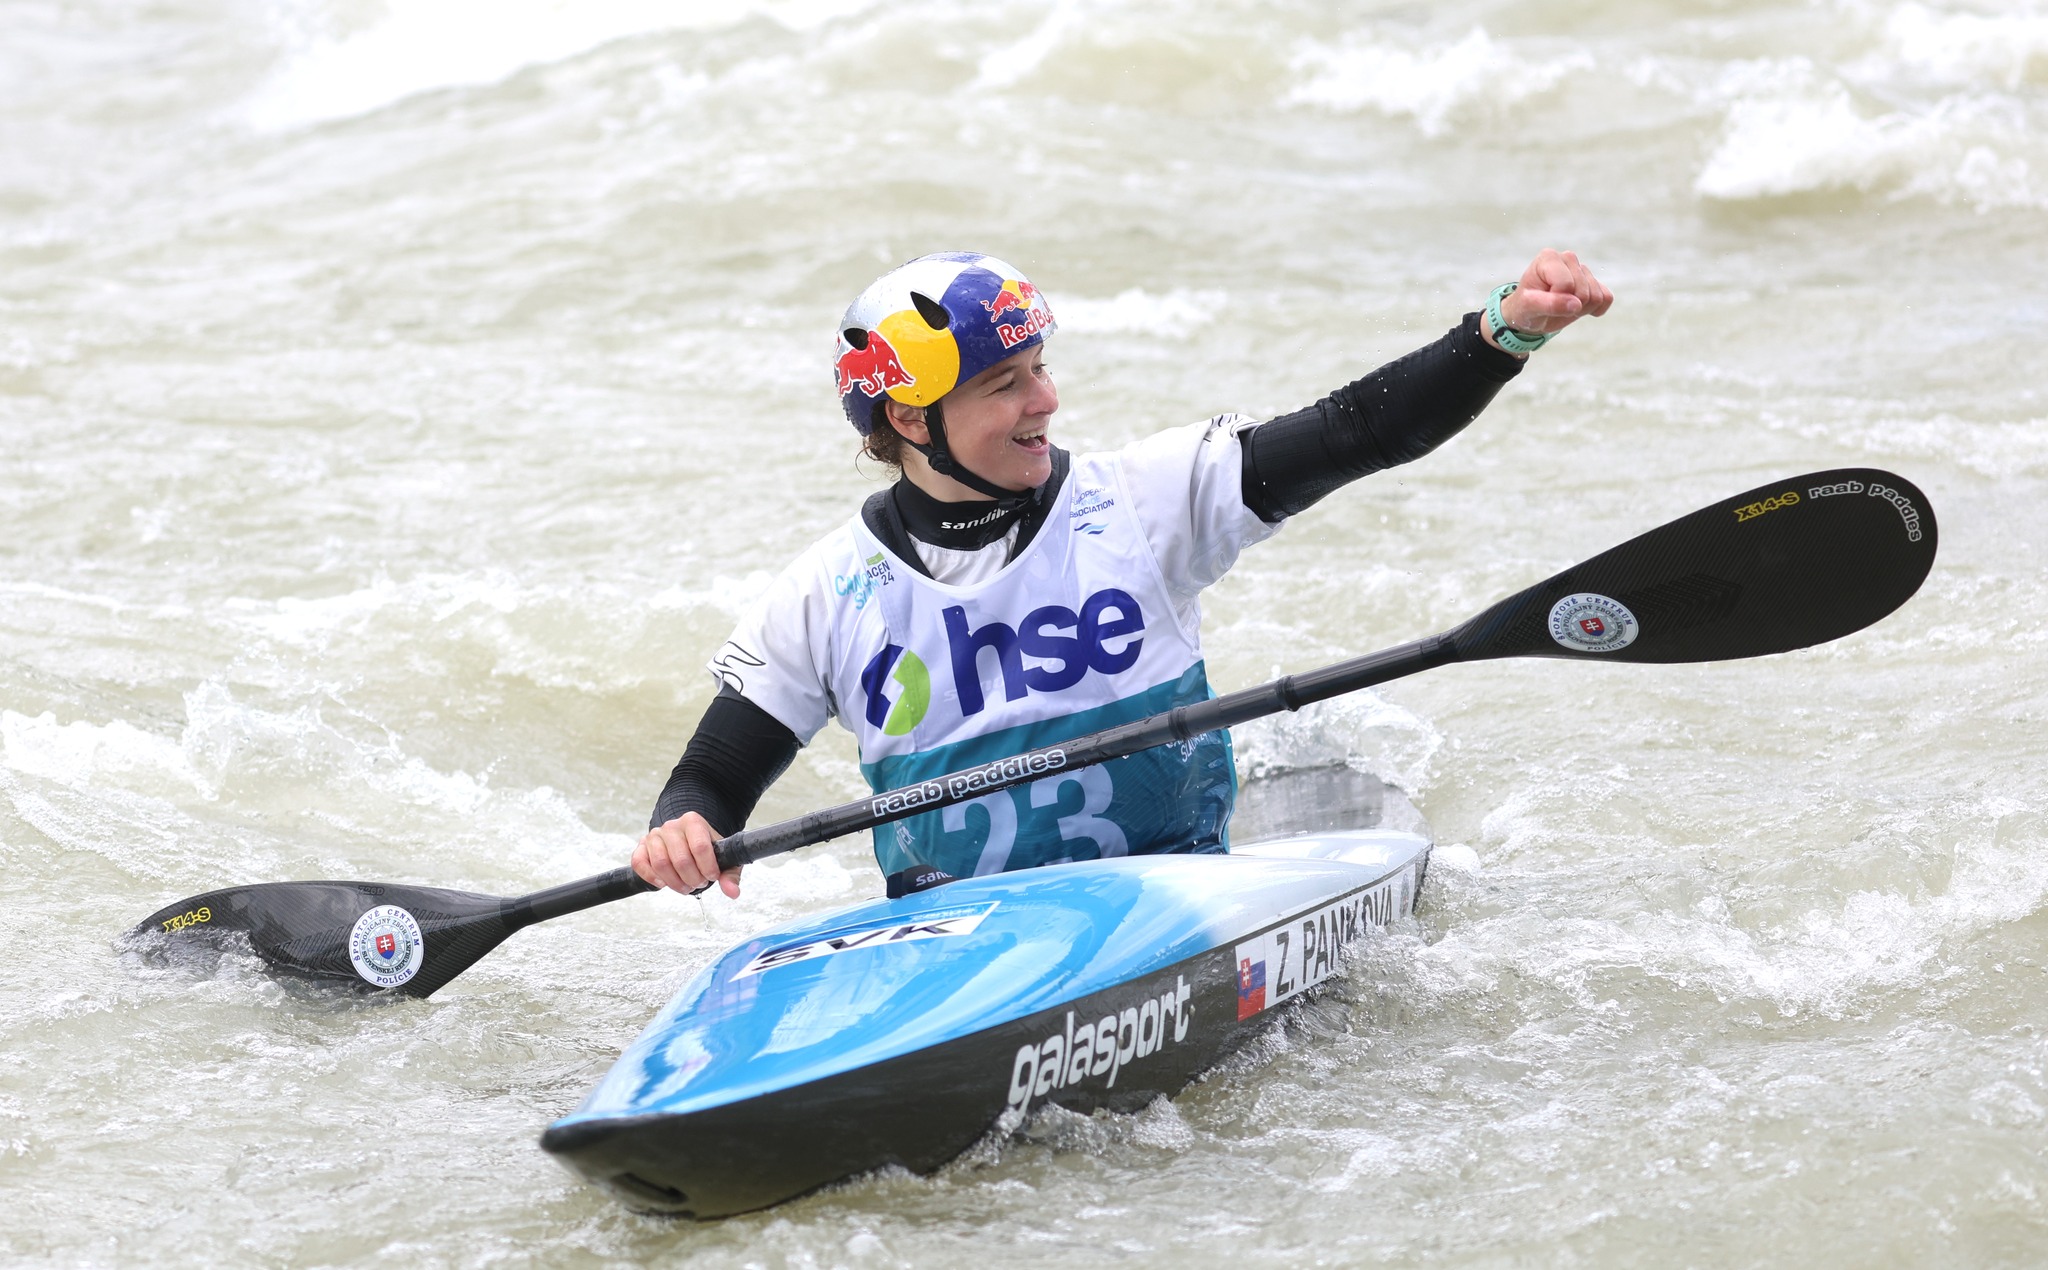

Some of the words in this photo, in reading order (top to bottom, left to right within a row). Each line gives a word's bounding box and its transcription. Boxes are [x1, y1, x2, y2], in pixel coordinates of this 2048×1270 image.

[997, 310, 1039, 348] Red
[1734, 492, 1800, 522] X14-S
[1808, 481, 1864, 499] raab
[1868, 483, 1922, 542] paddles
[866, 560, 890, 579] ACEN
[881, 571, 895, 586] 24
[1586, 597, 1633, 625] CENTRUM
[942, 588, 1145, 717] hse
[872, 781, 943, 817] raab
[949, 749, 1067, 799] paddles
[942, 762, 1129, 878] 23
[162, 907, 211, 934] X14-S
[387, 909, 420, 946] CENTRUM
[750, 918, 963, 972] SVK
[1276, 931, 1294, 998] Z.
[1007, 974, 1191, 1122] galasport
